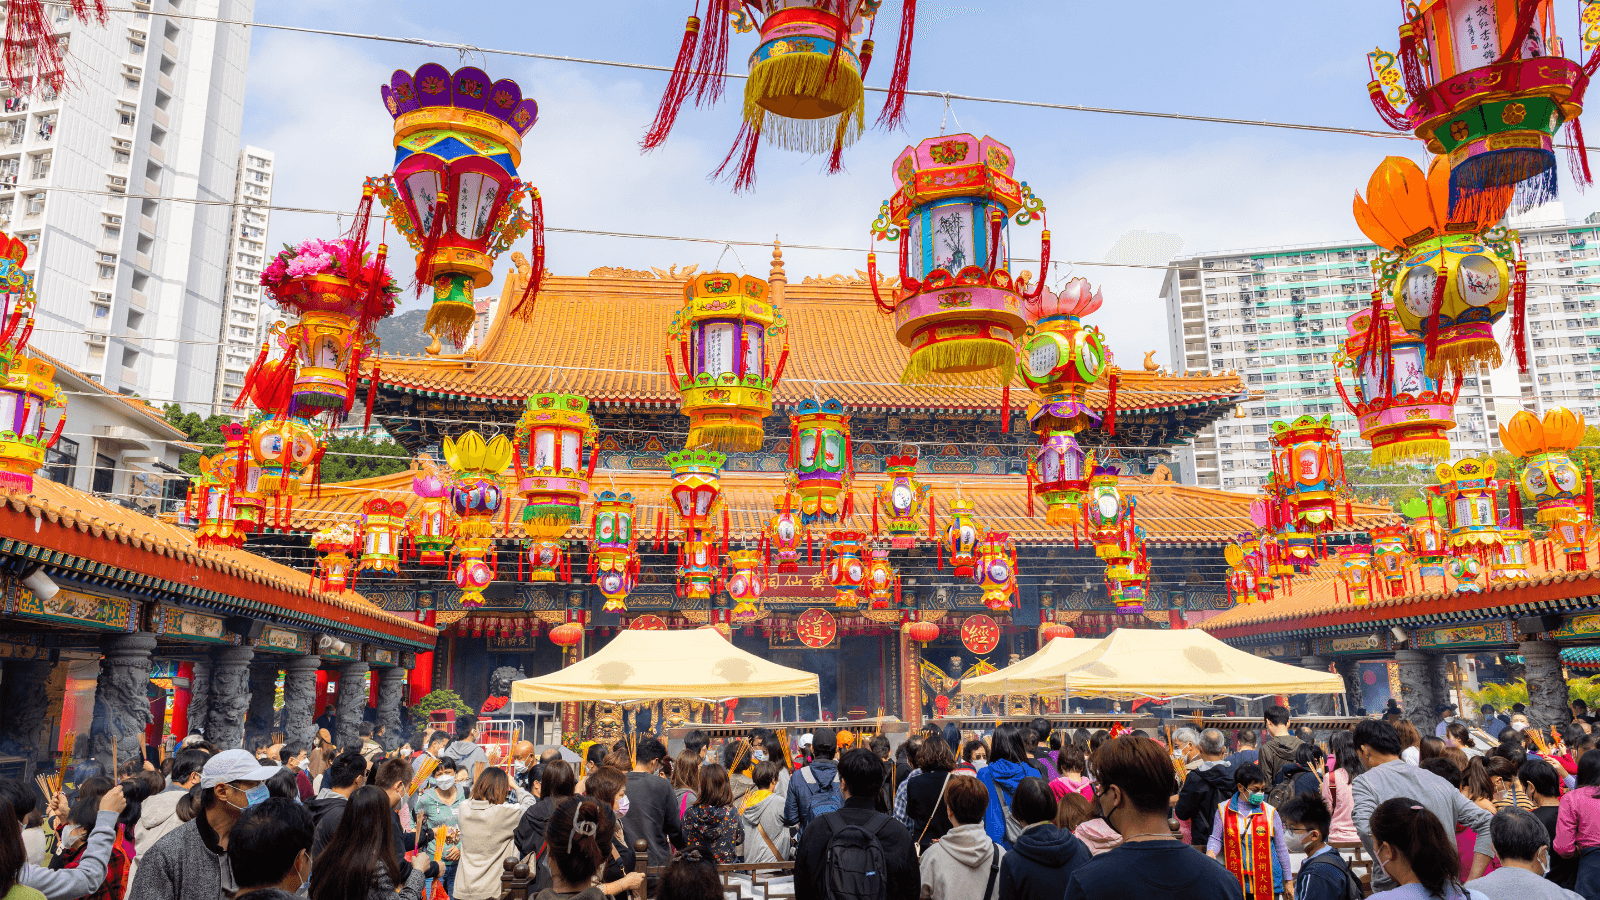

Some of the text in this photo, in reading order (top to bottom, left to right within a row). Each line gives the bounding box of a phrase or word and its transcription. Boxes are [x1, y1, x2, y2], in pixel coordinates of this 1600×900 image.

[804, 615, 828, 641] 道
[968, 624, 990, 645] 經
[1257, 839, 1270, 895] 大仙祠大使
